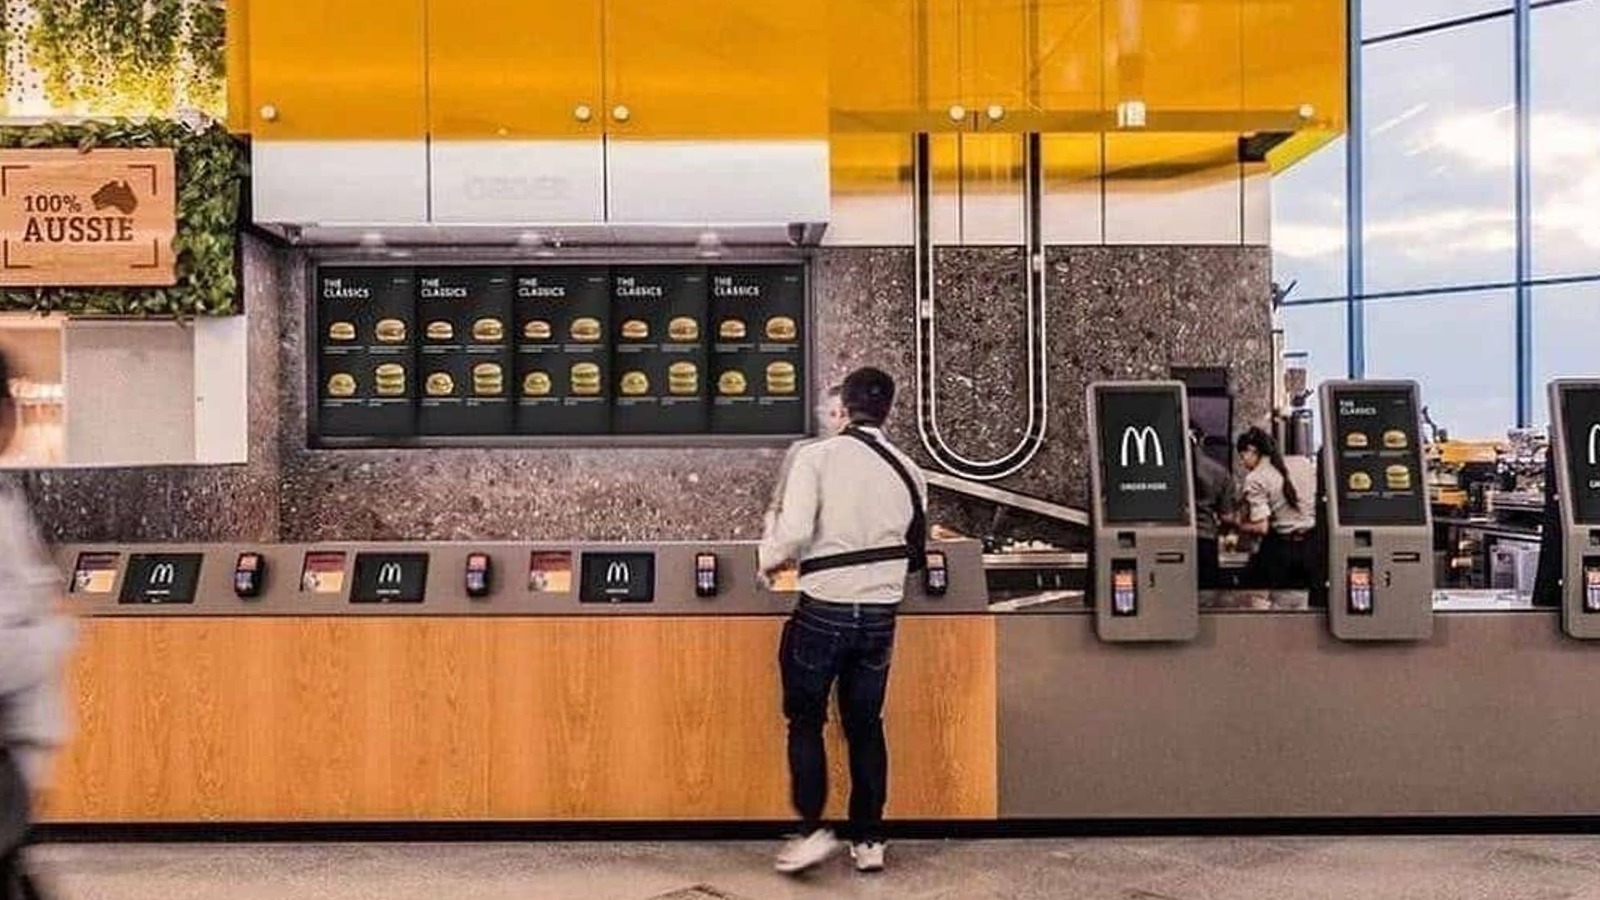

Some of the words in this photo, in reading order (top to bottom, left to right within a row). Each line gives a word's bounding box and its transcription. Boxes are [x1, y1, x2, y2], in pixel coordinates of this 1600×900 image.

[24, 195, 82, 213] 100%
[23, 216, 134, 243] AUSSIE
[324, 278, 341, 287] THE
[421, 278, 439, 287] THE
[518, 278, 537, 287] THE
[617, 277, 635, 286] THE
[714, 277, 732, 286] THE
[324, 288, 370, 298] CLASSICS
[421, 287, 467, 297] CLASSICS
[518, 287, 565, 297] CLASSICS
[617, 286, 662, 296] CLASSICS
[714, 286, 760, 296] CLASSICS
